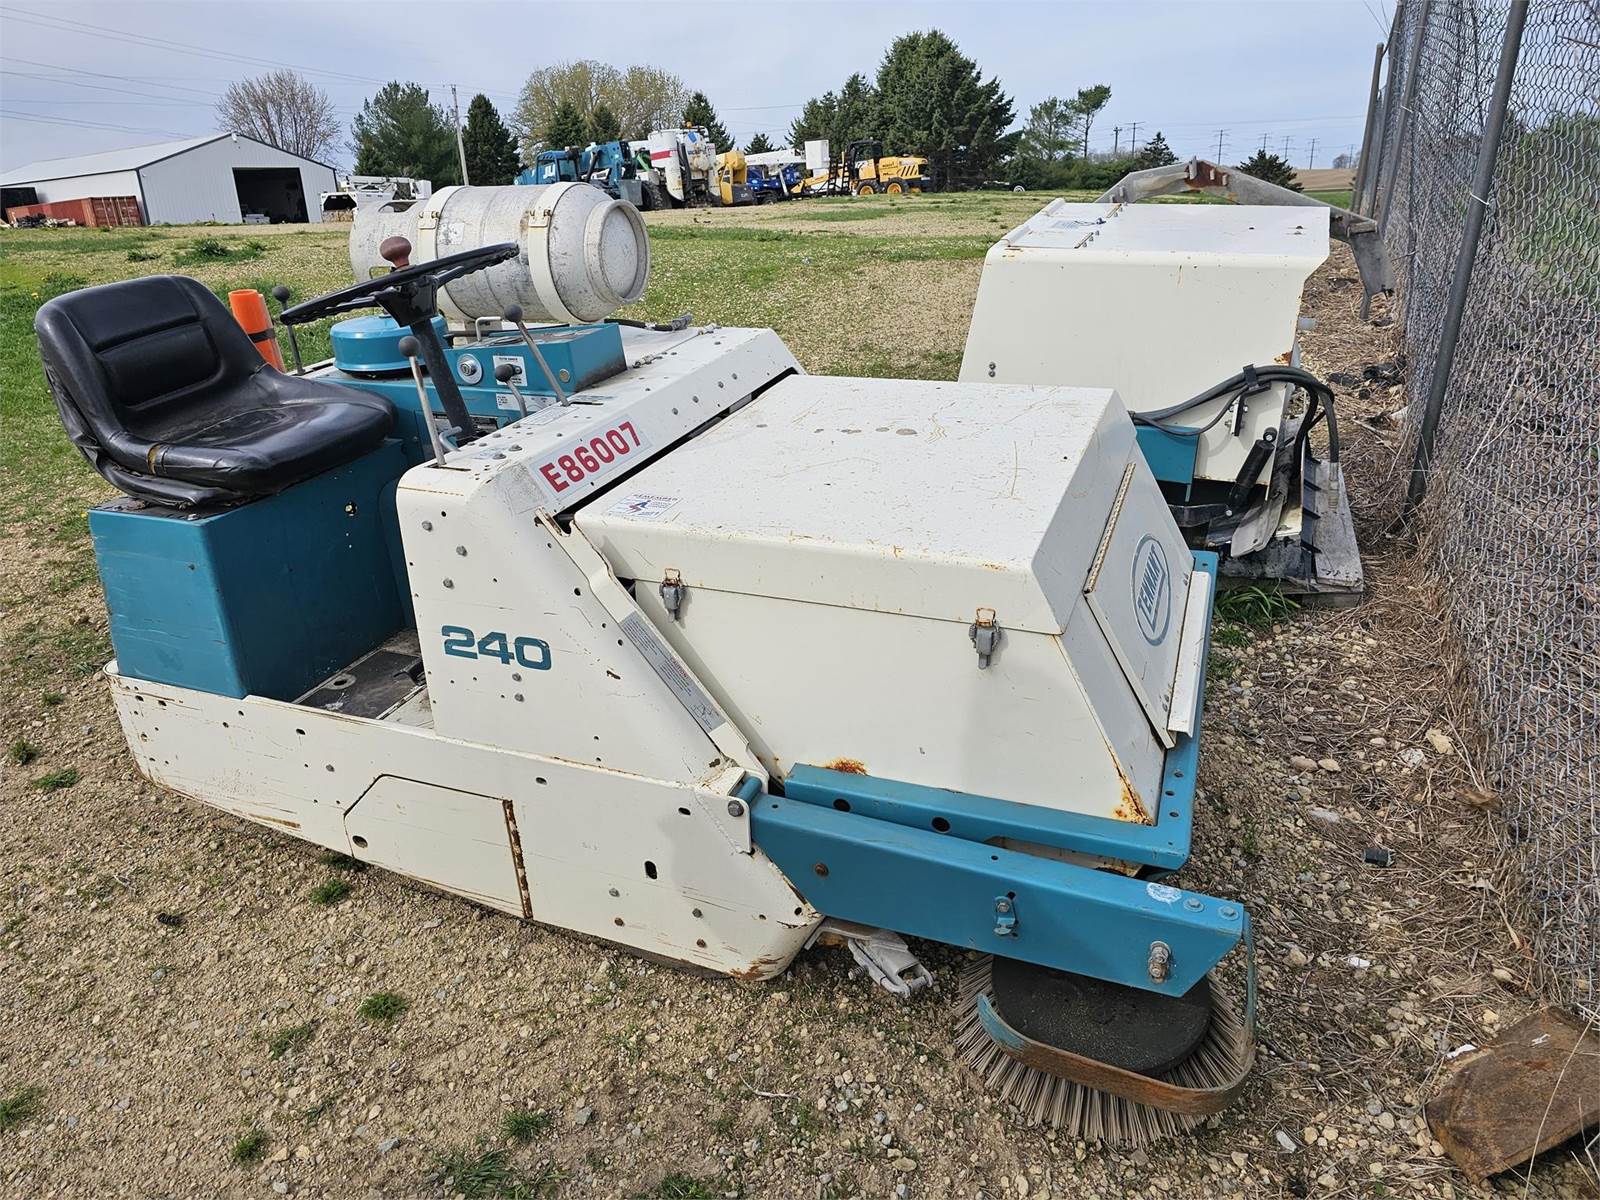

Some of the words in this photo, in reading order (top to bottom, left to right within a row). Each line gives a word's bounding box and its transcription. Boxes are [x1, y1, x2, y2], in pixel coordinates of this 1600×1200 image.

[539, 421, 641, 493] E86007
[1137, 543, 1166, 632] TENNANT
[441, 624, 552, 671] 240
